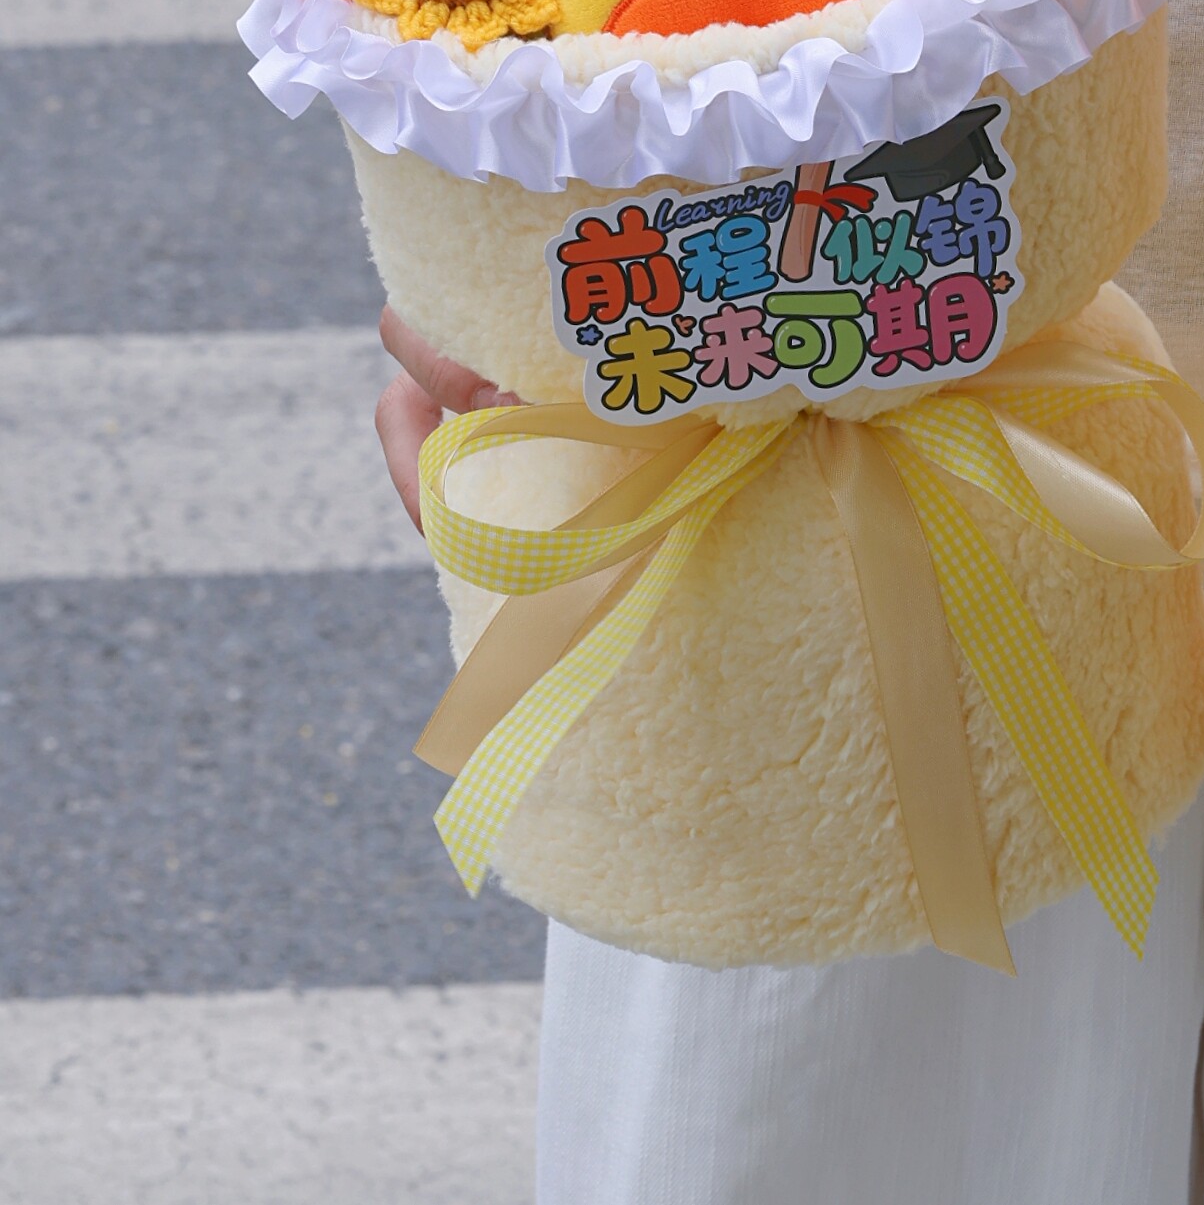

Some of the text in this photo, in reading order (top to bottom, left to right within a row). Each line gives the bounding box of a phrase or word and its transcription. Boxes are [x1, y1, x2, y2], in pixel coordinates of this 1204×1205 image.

[558, 177, 1010, 325] 前程似锦
[653, 181, 794, 234] Learning
[599, 272, 998, 414] 未来可期
